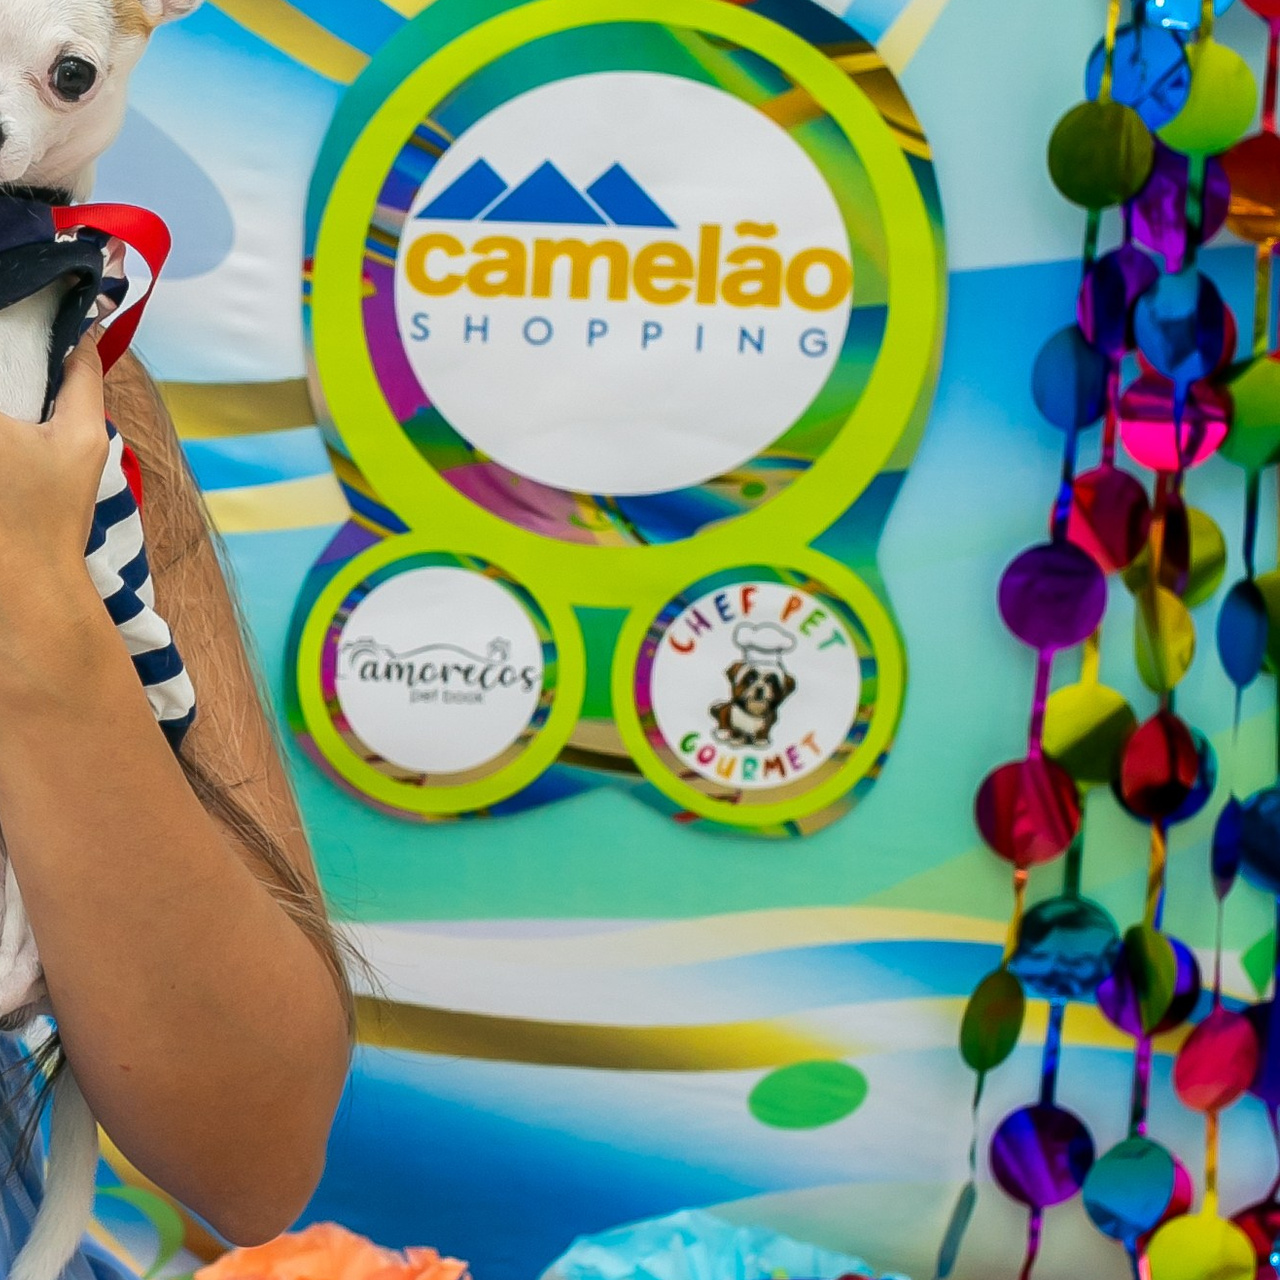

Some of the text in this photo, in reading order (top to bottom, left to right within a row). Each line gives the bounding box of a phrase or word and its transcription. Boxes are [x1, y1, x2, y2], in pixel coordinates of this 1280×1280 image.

[404, 221, 854, 312] camelão
[410, 312, 829, 358] SHOPPING
[669, 585, 848, 655] CHEF PET
[680, 731, 822, 781] GOURMET
